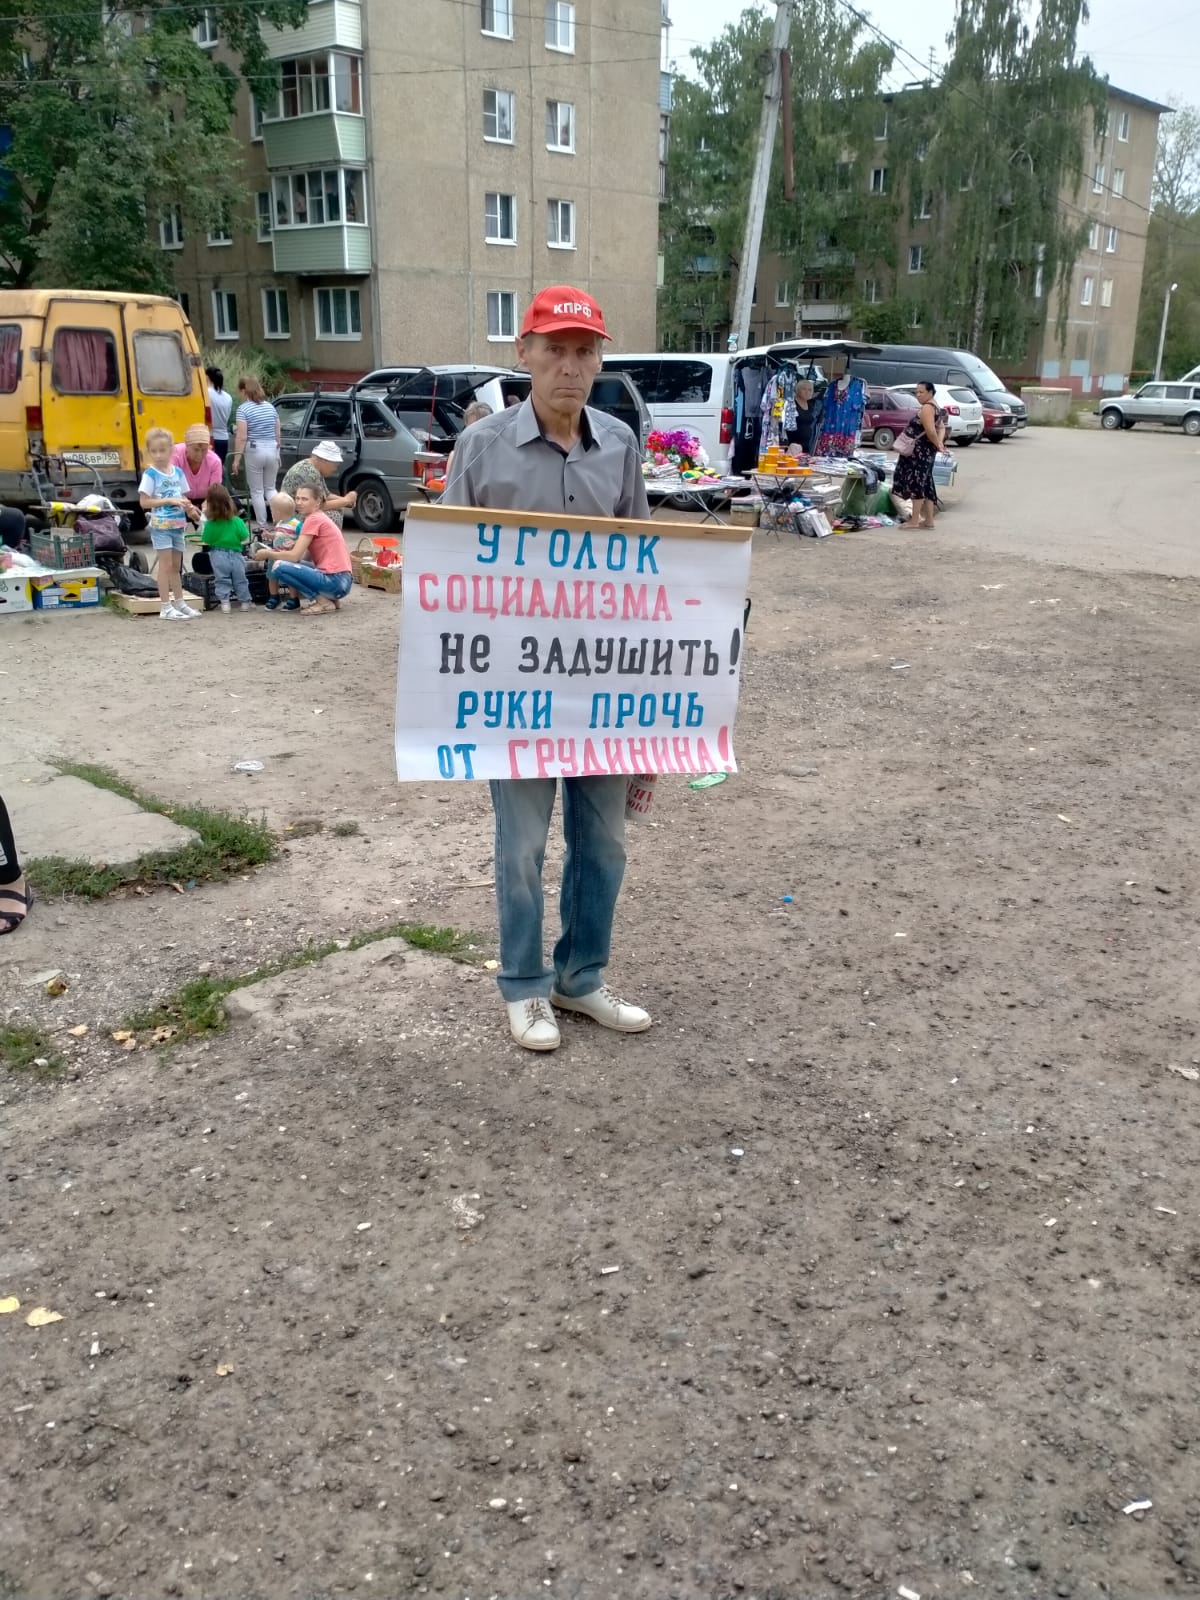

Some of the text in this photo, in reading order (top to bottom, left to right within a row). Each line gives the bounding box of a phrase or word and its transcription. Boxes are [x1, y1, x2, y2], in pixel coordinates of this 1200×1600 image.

[553, 302, 592, 318] КПРФ
[104, 452, 116, 461] 750
[476, 522, 661, 575] УГОЛОК
[418, 572, 673, 621] СОЦИАЛИЗМА
[517, 628, 741, 678] ЗАДУШИТЬ!
[455, 689, 705, 730] РУКИ ПРОЧЬ
[436, 725, 734, 780] ОТ ГРУДИНИНА!
